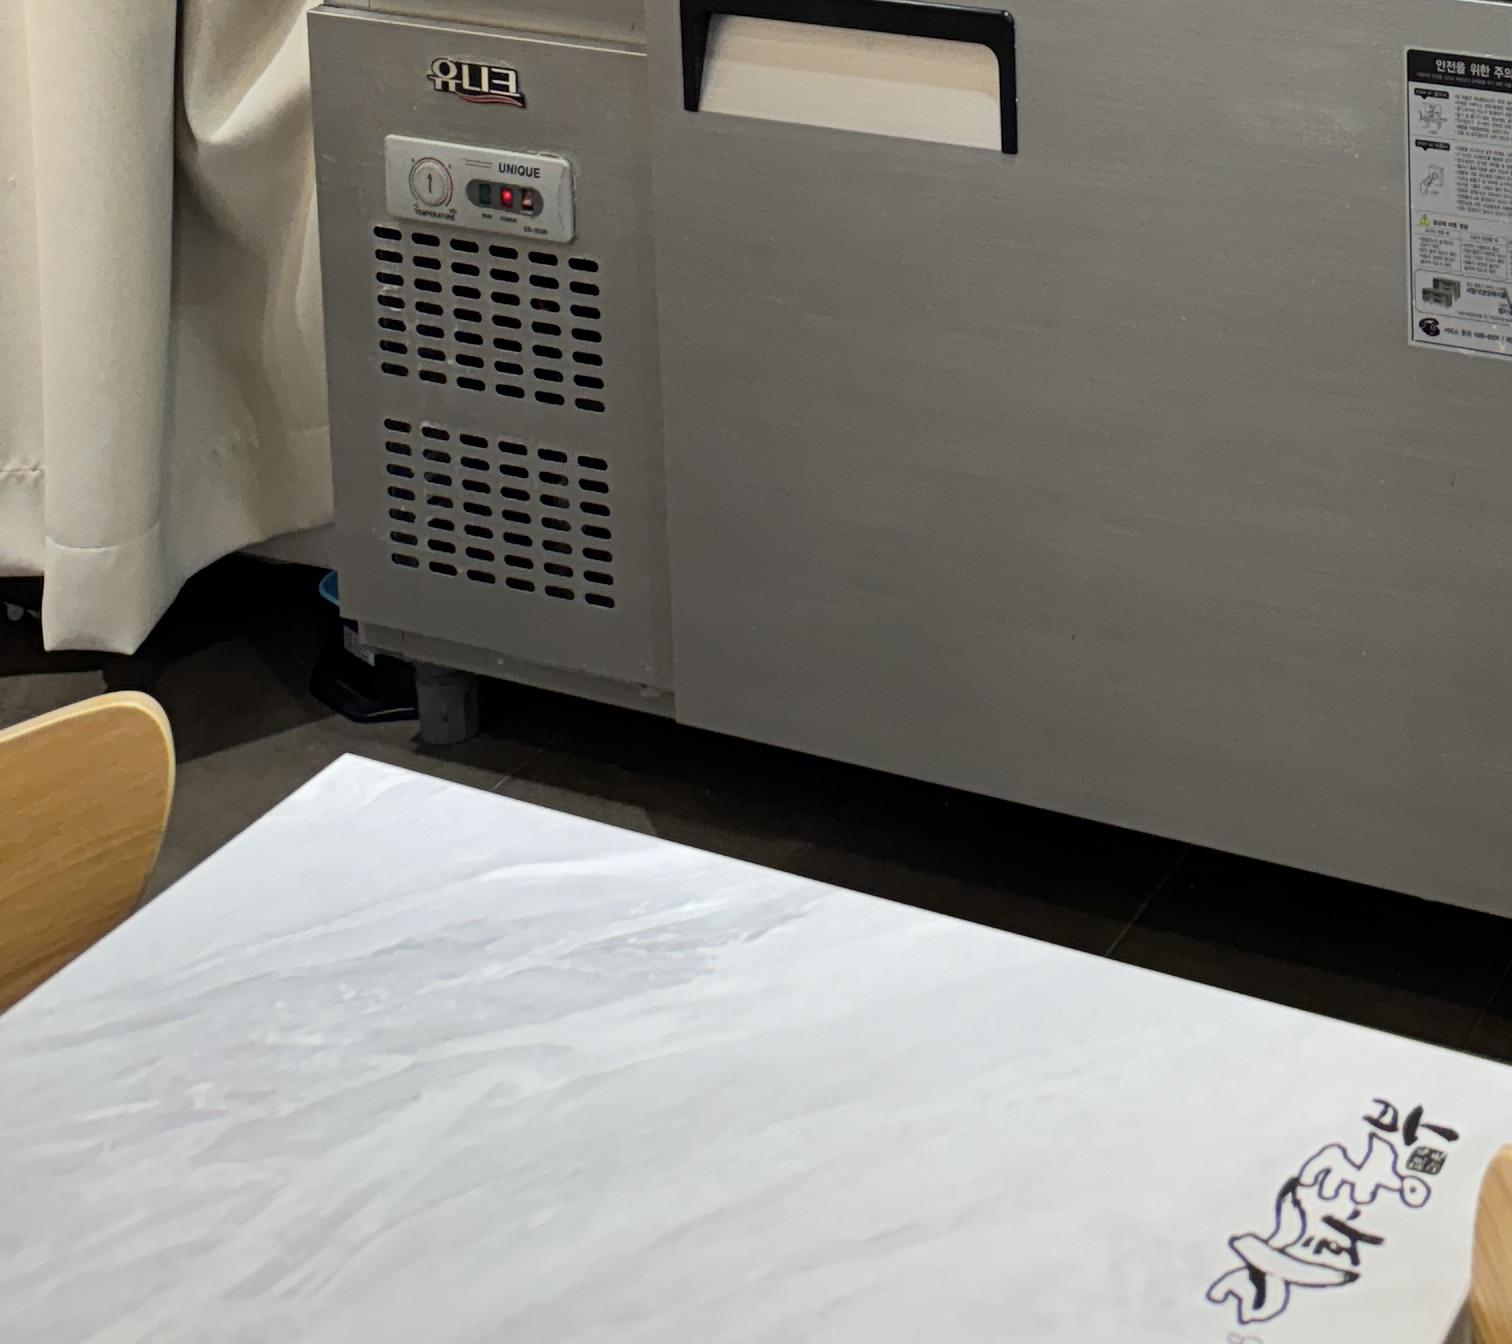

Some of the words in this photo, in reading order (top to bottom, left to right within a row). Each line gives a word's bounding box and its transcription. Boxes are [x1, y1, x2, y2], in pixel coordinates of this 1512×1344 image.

[1435, 59, 1466, 75] 안전을
[1470, 62, 1490, 77] 위한
[427, 57, 522, 98] 유니크
[498, 162, 541, 179] UNIQUE
